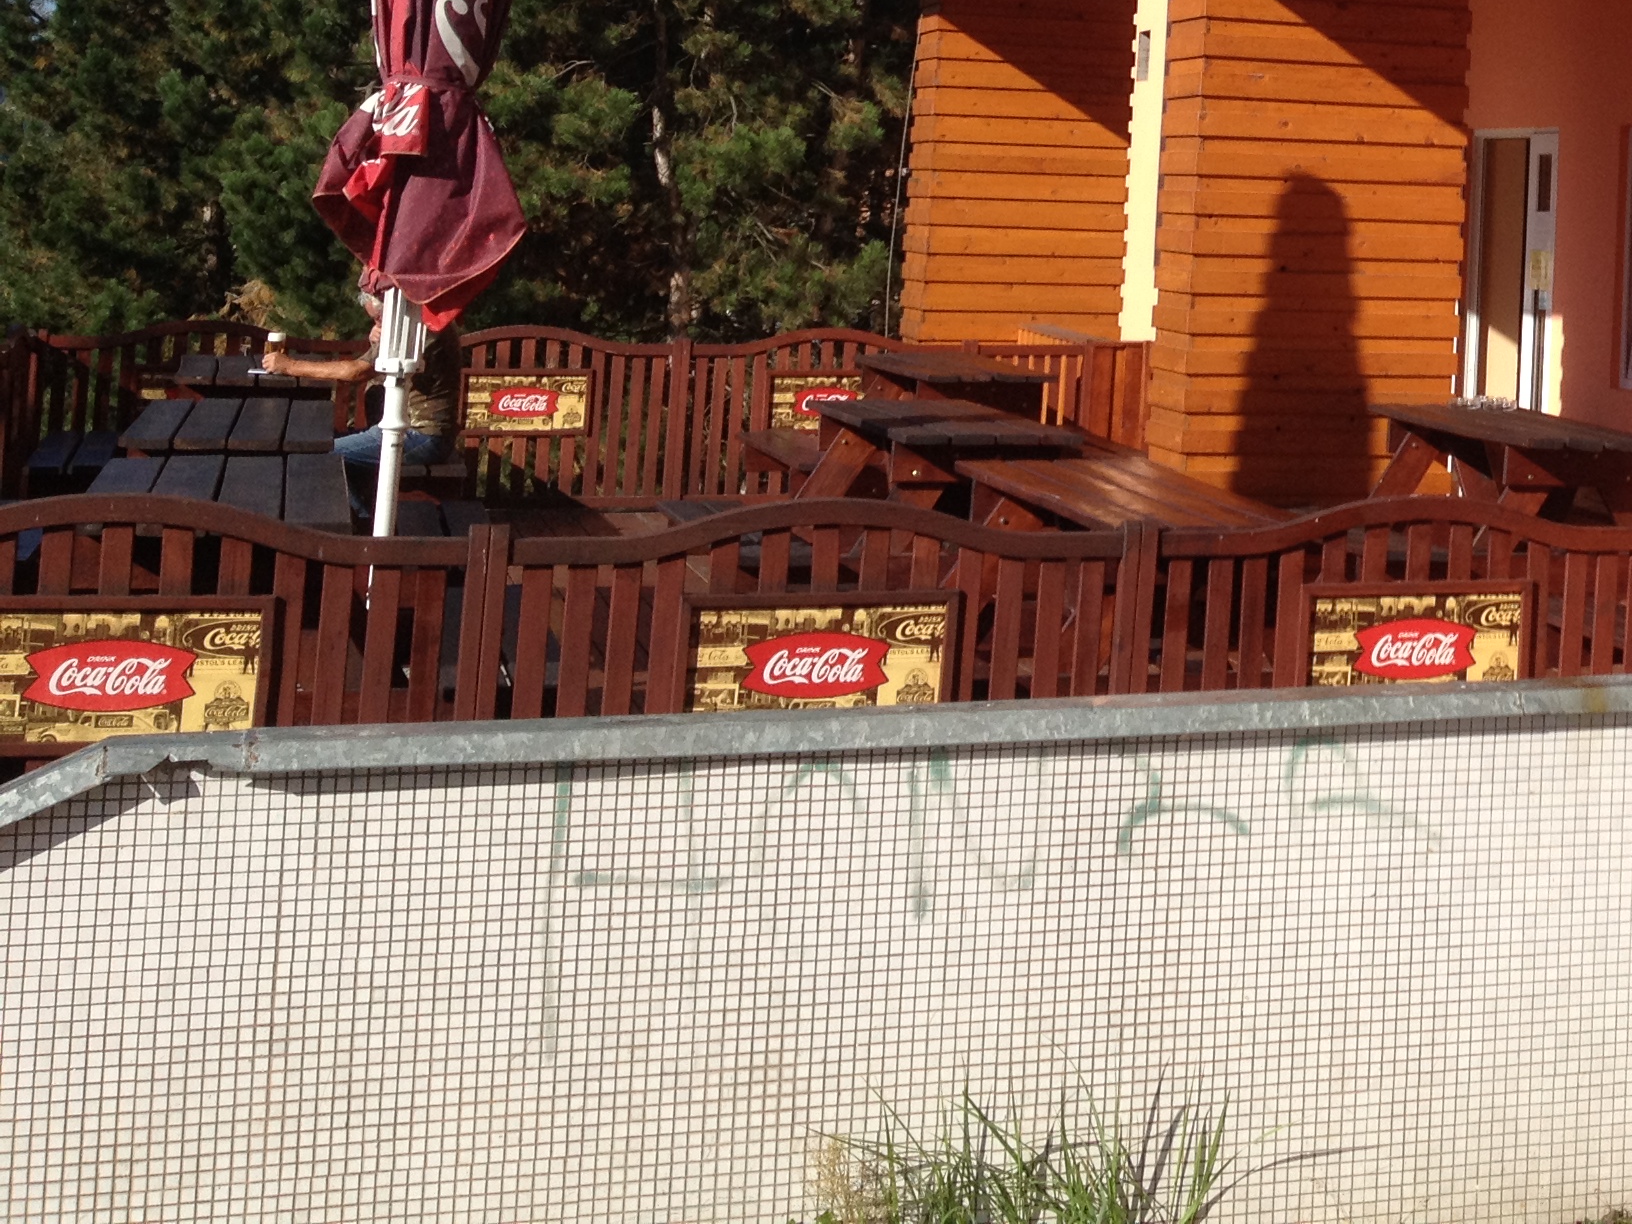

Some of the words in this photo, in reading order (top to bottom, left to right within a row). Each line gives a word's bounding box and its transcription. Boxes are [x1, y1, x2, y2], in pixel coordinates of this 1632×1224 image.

[498, 394, 550, 412] Coca-Cola
[763, 647, 869, 685] Coca-Cola
[1371, 633, 1459, 668] Coca-Cola
[48, 657, 172, 695] Coca-Cola
